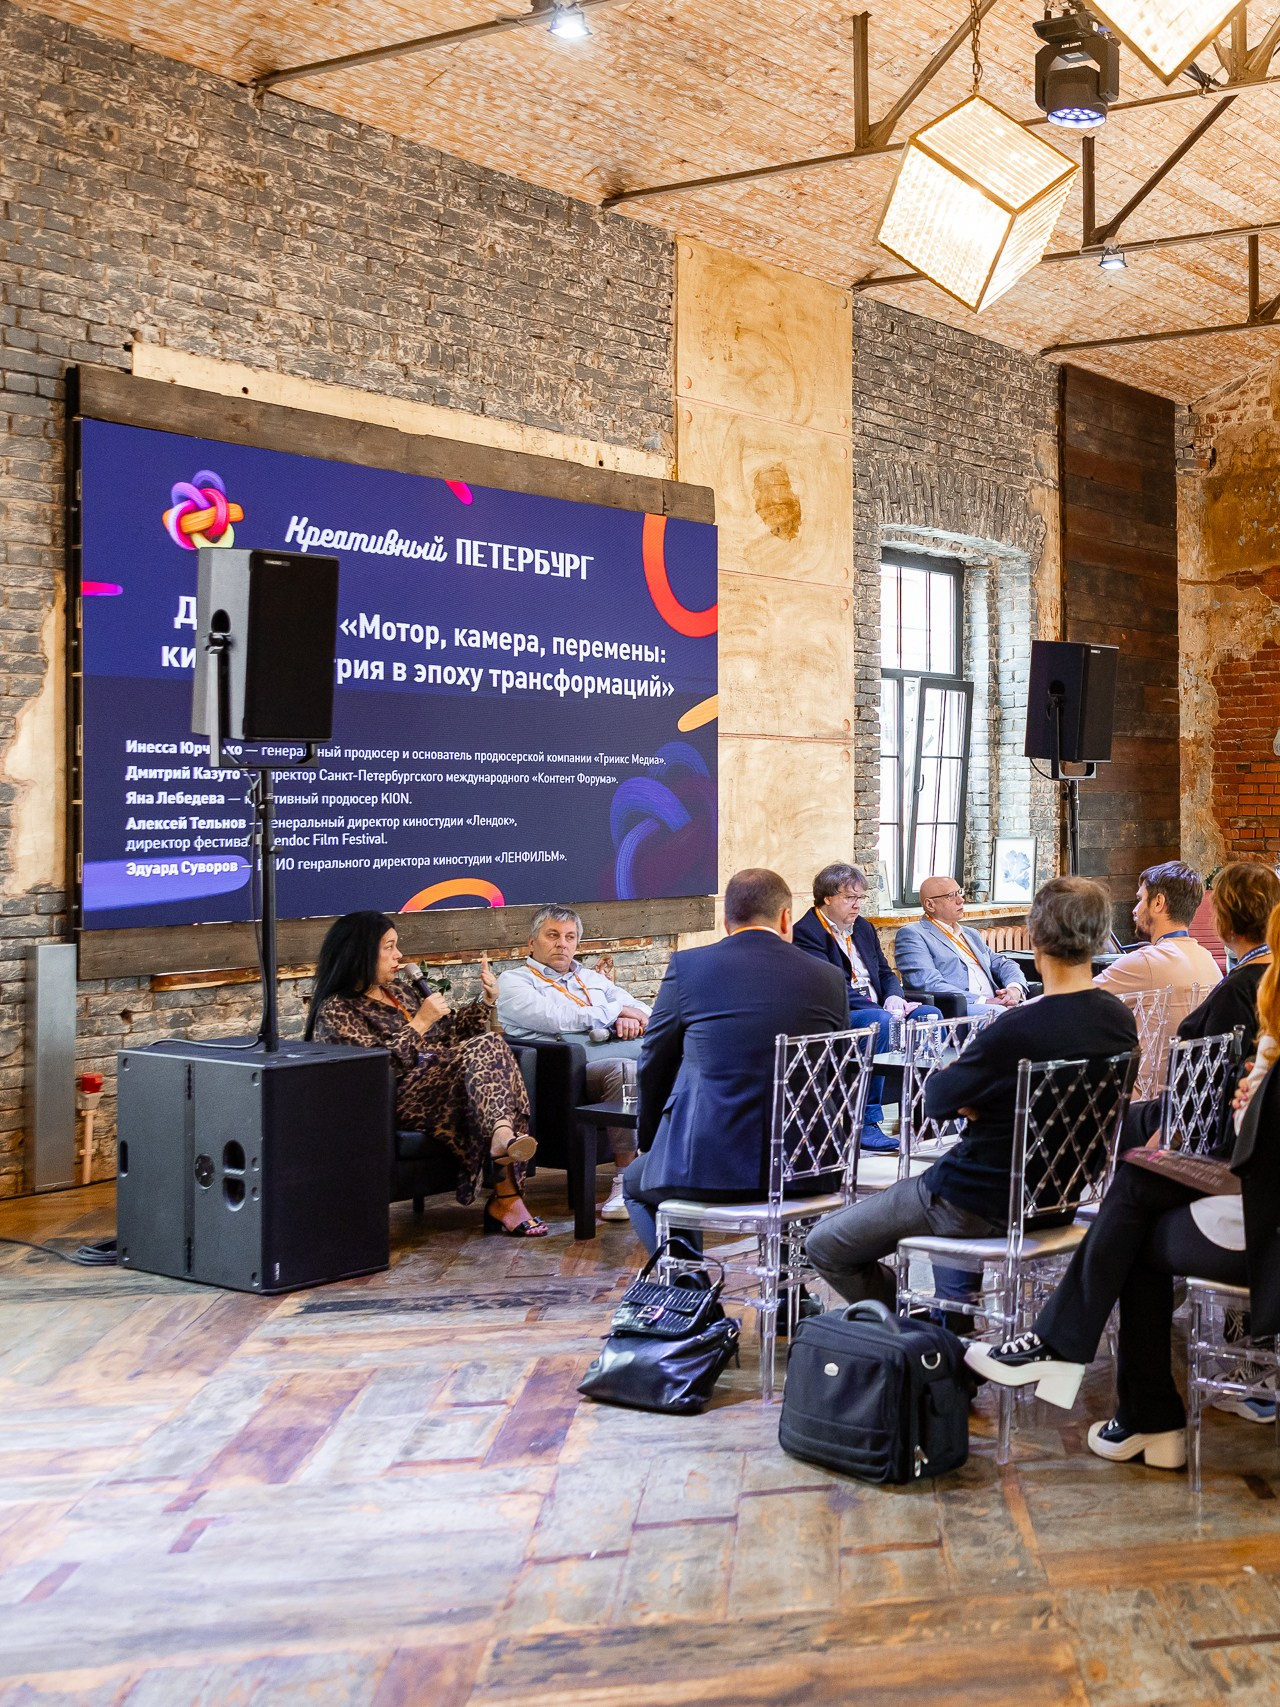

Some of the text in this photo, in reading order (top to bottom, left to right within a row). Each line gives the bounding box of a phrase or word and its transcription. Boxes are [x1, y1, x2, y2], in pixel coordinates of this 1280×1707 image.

[284, 515, 594, 580] Креативный ПЕТЕРБУРГ
[339, 612, 666, 663] «Мотор, камера, перемены:
[392, 661, 407, 682] в
[413, 662, 484, 692] эпоху
[489, 668, 675, 700] трансформаций»
[125, 740, 178, 754] Инесса
[180, 741, 243, 757] Юрчко
[261, 746, 341, 760] генераный
[344, 748, 400, 762] продюсер
[402, 750, 410, 760] и
[412, 749, 472, 761] основатель
[474, 751, 544, 763] продюсерской
[547, 753, 592, 764] компании
[631, 754, 667, 766] Медиа».
[125, 766, 190, 781] Дмитрий
[193, 767, 240, 782] Казуто
[271, 770, 315, 783] ректор
[319, 769, 443, 784] Санкт-Петербургского
[446, 772, 530, 785] международного
[532, 772, 575, 784] «Контент
[577, 772, 619, 786] Форума».
[125, 791, 154, 804] Яна
[156, 791, 225, 806] Лебедева
[244, 793, 318, 806] ктивный
[321, 794, 379, 807] продюсер
[381, 793, 412, 804] KION.
[125, 816, 187, 830] Алексей
[189, 816, 247, 830] Тельнов
[271, 816, 345, 831] енеральный
[347, 817, 400, 830] директор
[402, 816, 464, 829] киностудии
[466, 815, 518, 828] «Лендок»,
[125, 839, 191, 852] директор
[274, 834, 310, 847] endoc
[313, 834, 339, 846] Film
[342, 833, 388, 845] Festival.
[125, 862, 179, 877] Эдуард
[181, 861, 239, 876] Суворов
[298, 858, 371, 872] генрального
[373, 856, 430, 870] директора
[433, 854, 492, 868] киностудии
[494, 851, 568, 864] «ЛЕНФИЛЬМ».
